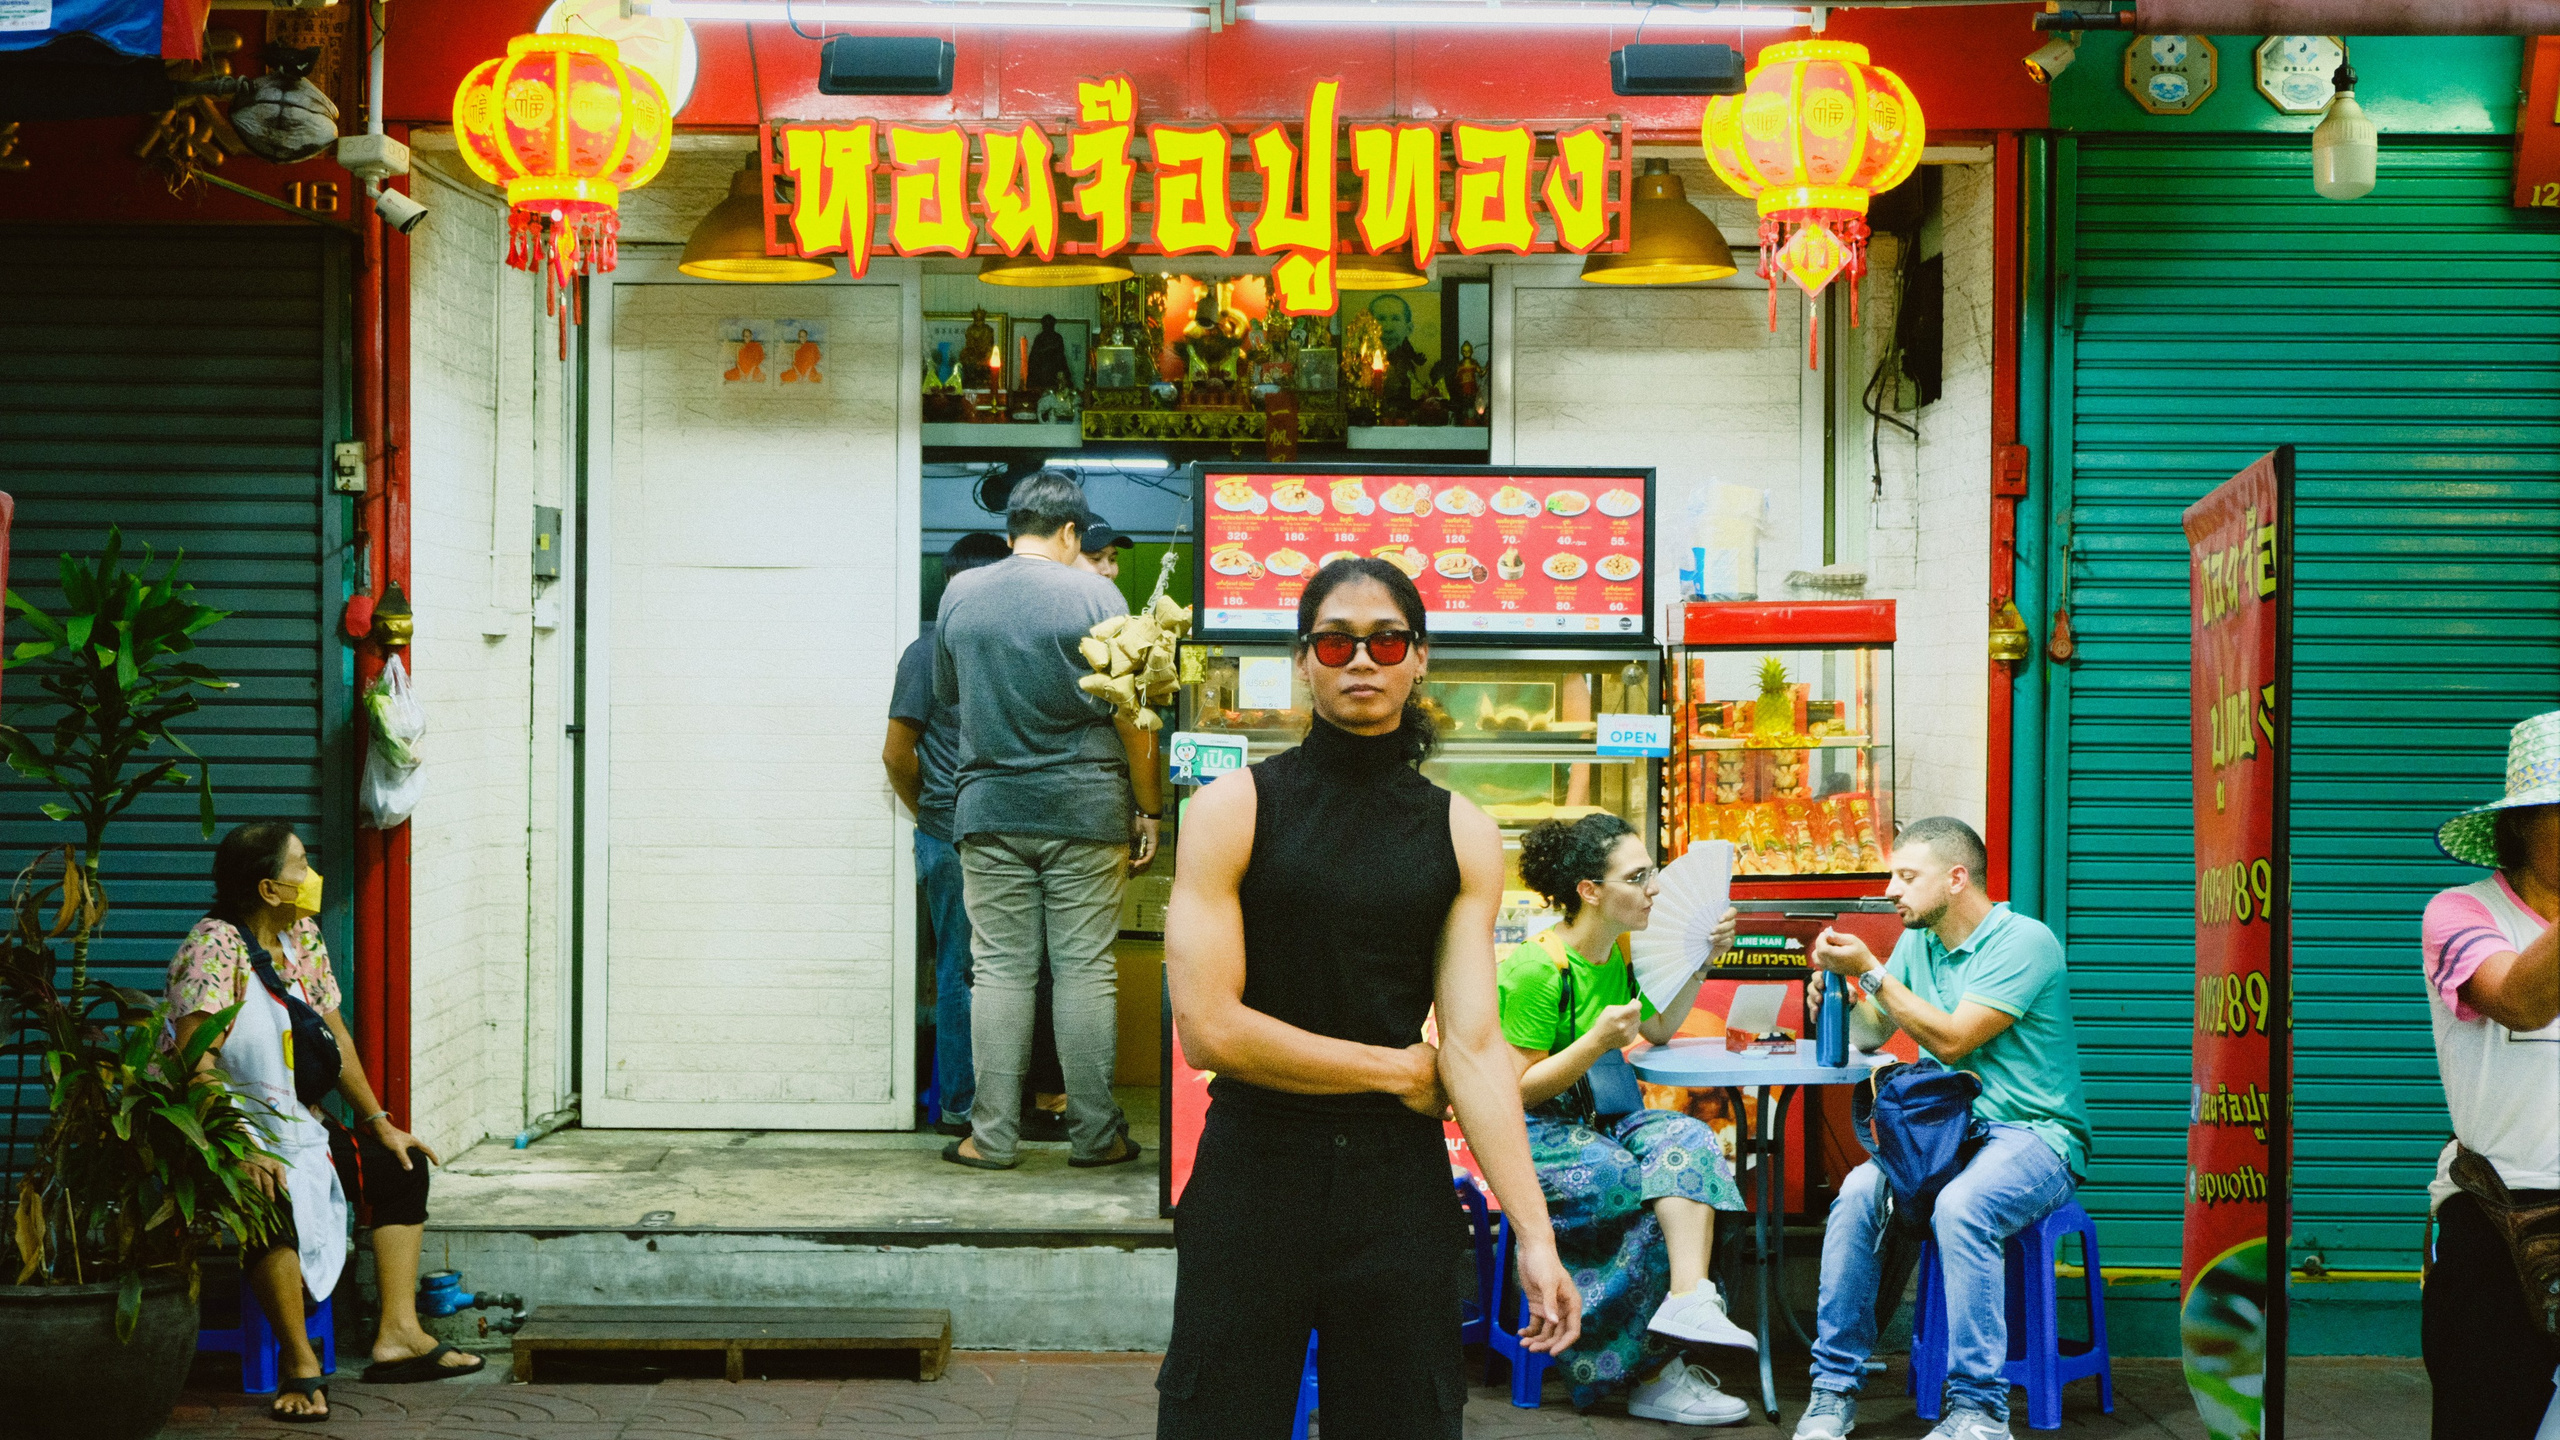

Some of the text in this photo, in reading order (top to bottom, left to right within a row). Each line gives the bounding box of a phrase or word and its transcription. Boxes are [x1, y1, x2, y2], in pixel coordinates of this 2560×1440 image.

[287, 181, 339, 212] 16
[1610, 730, 1657, 744] OPEN
[1202, 749, 1236, 768] เปิด
[1736, 937, 1783, 946] LINE MAN
